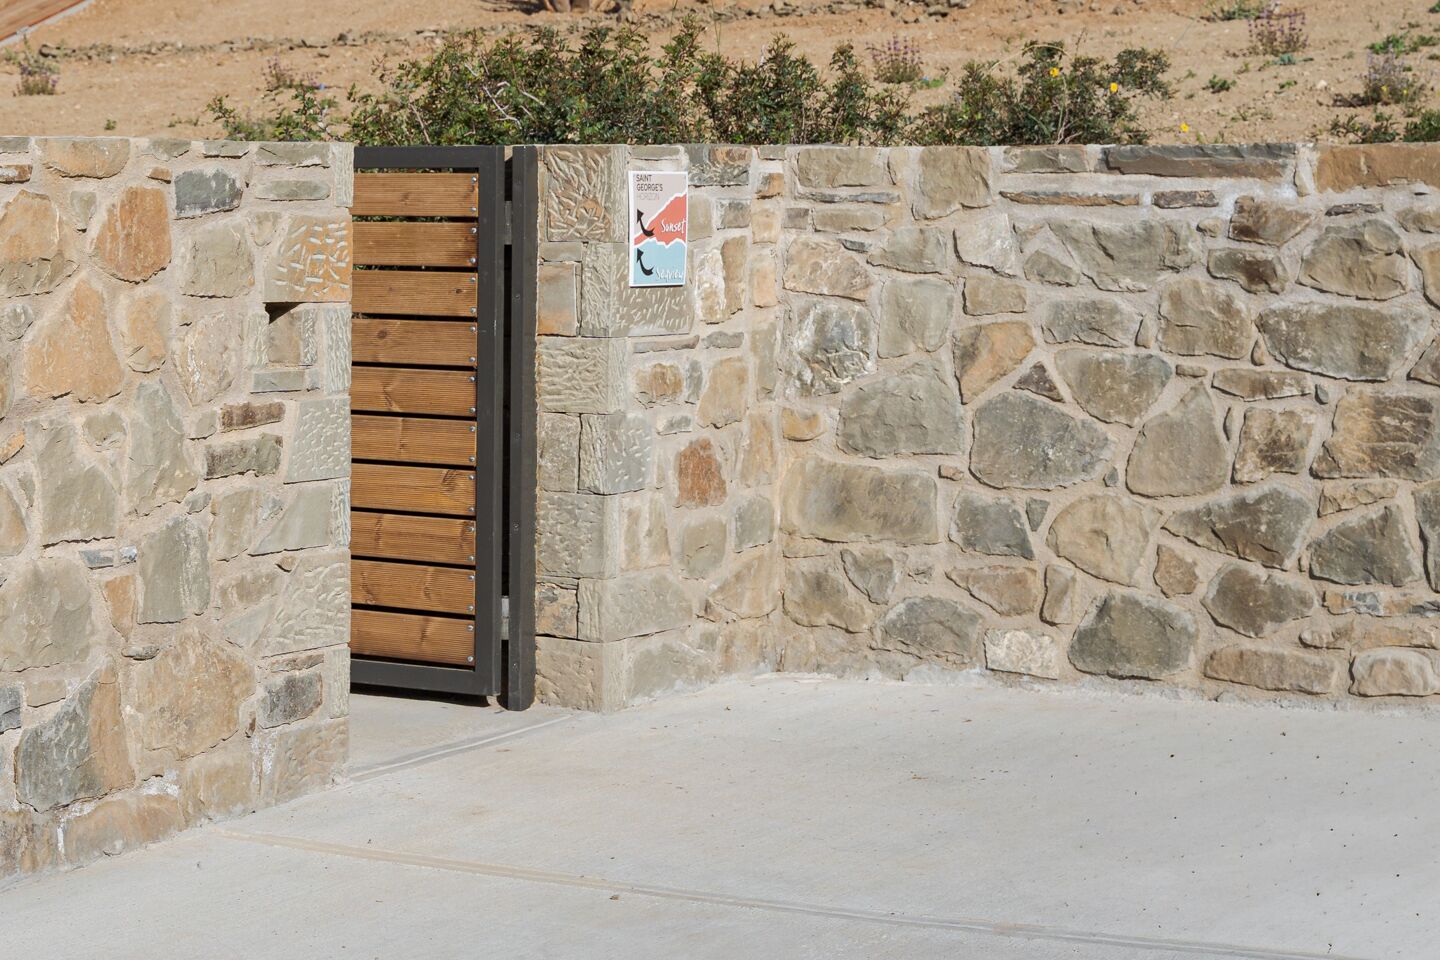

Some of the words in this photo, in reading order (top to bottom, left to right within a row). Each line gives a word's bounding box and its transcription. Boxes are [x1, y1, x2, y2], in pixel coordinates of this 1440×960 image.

[635, 174, 652, 182] SAINT
[636, 183, 663, 192] GEORGE'S
[661, 218, 686, 234] Sunset
